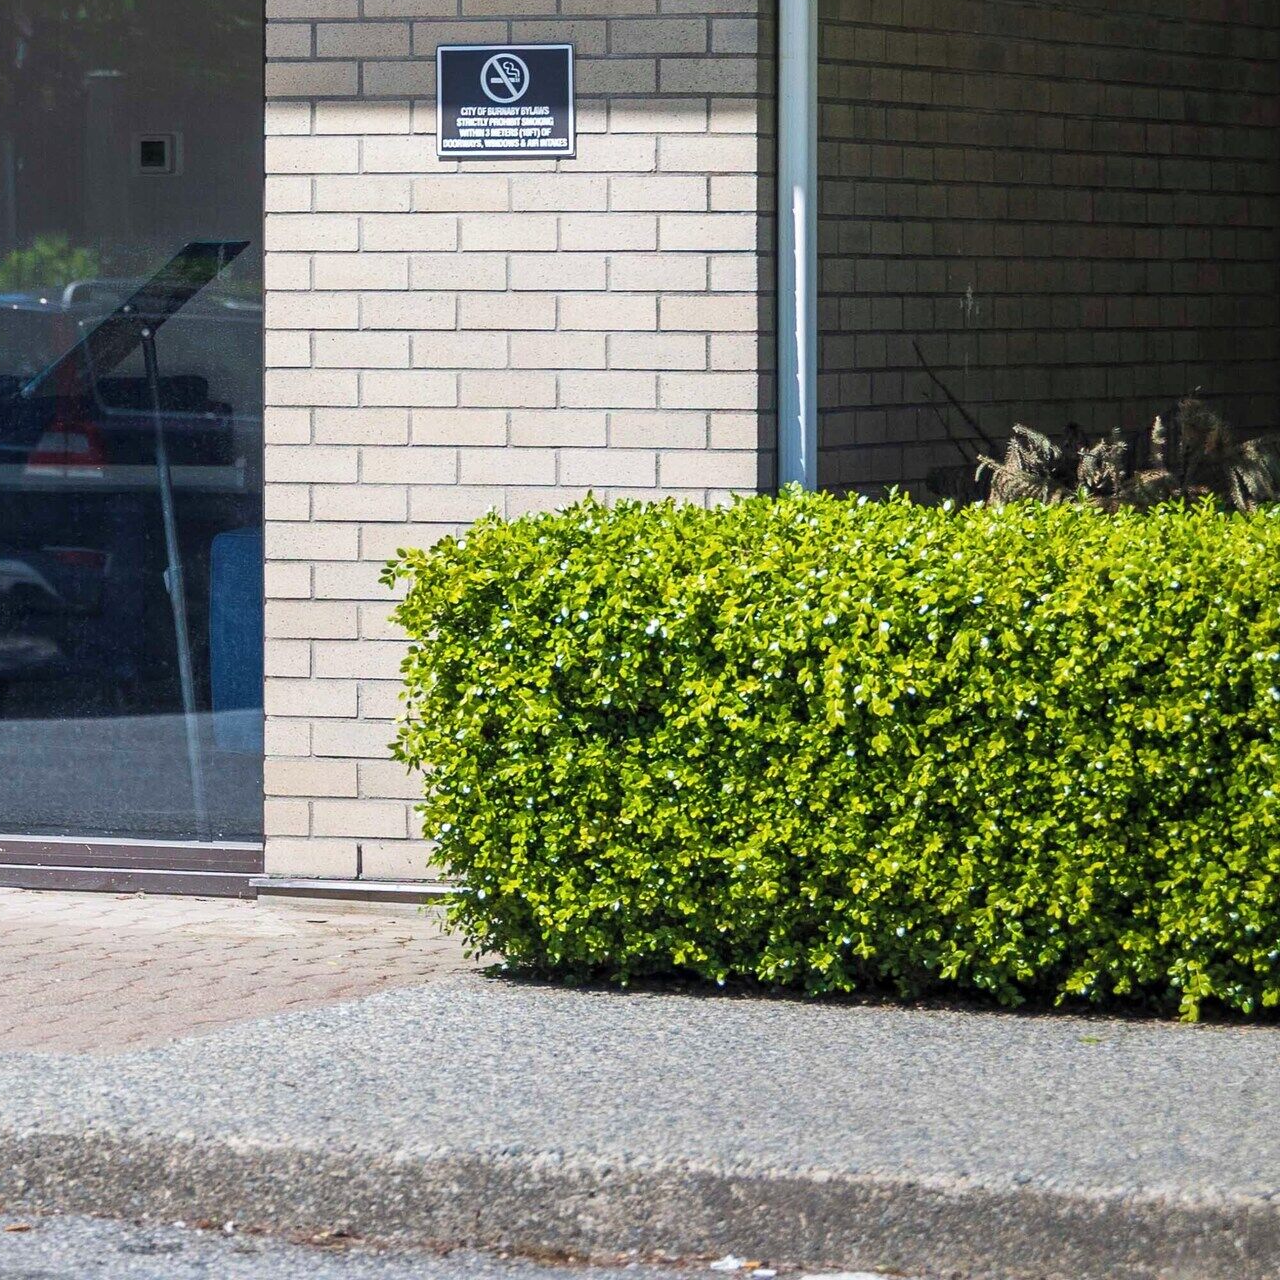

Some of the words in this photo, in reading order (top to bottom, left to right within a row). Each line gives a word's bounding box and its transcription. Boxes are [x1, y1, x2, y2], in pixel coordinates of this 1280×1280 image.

[460, 106, 477, 116] CITY
[477, 106, 487, 116] OF
[487, 106, 520, 116] BURNABY
[520, 106, 550, 116] BYLAWS
[456, 117, 489, 127] STRICTLY
[521, 117, 554, 126] SMOKING
[459, 128, 484, 137] WITHIN
[484, 128, 491, 137] 3
[541, 127, 552, 137] OF
[484, 138, 520, 147] WINDOWS
